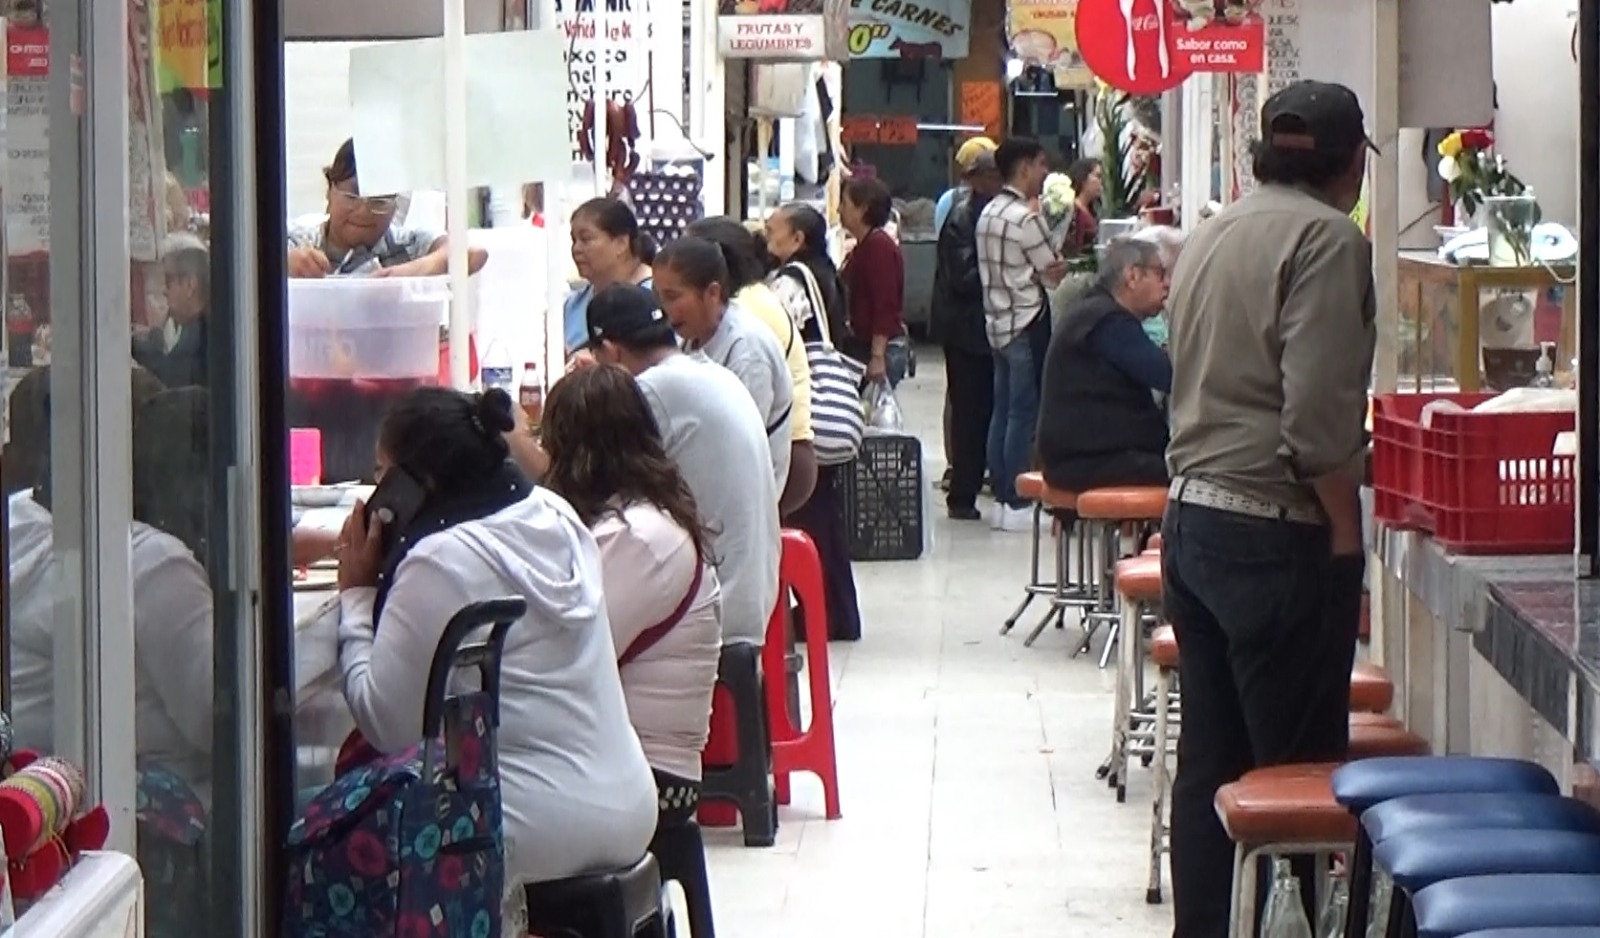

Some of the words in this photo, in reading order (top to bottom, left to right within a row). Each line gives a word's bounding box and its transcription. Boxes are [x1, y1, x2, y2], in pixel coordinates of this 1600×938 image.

[871, 0, 963, 36] CARNES
[737, 23, 791, 34] FRUTAS
[795, 23, 804, 33] Y
[730, 38, 812, 50] LEGUMBRES
[1176, 38, 1211, 50] Sabor
[1213, 40, 1247, 50] como
[1190, 53, 1207, 63] en
[1210, 53, 1238, 63] casa.
